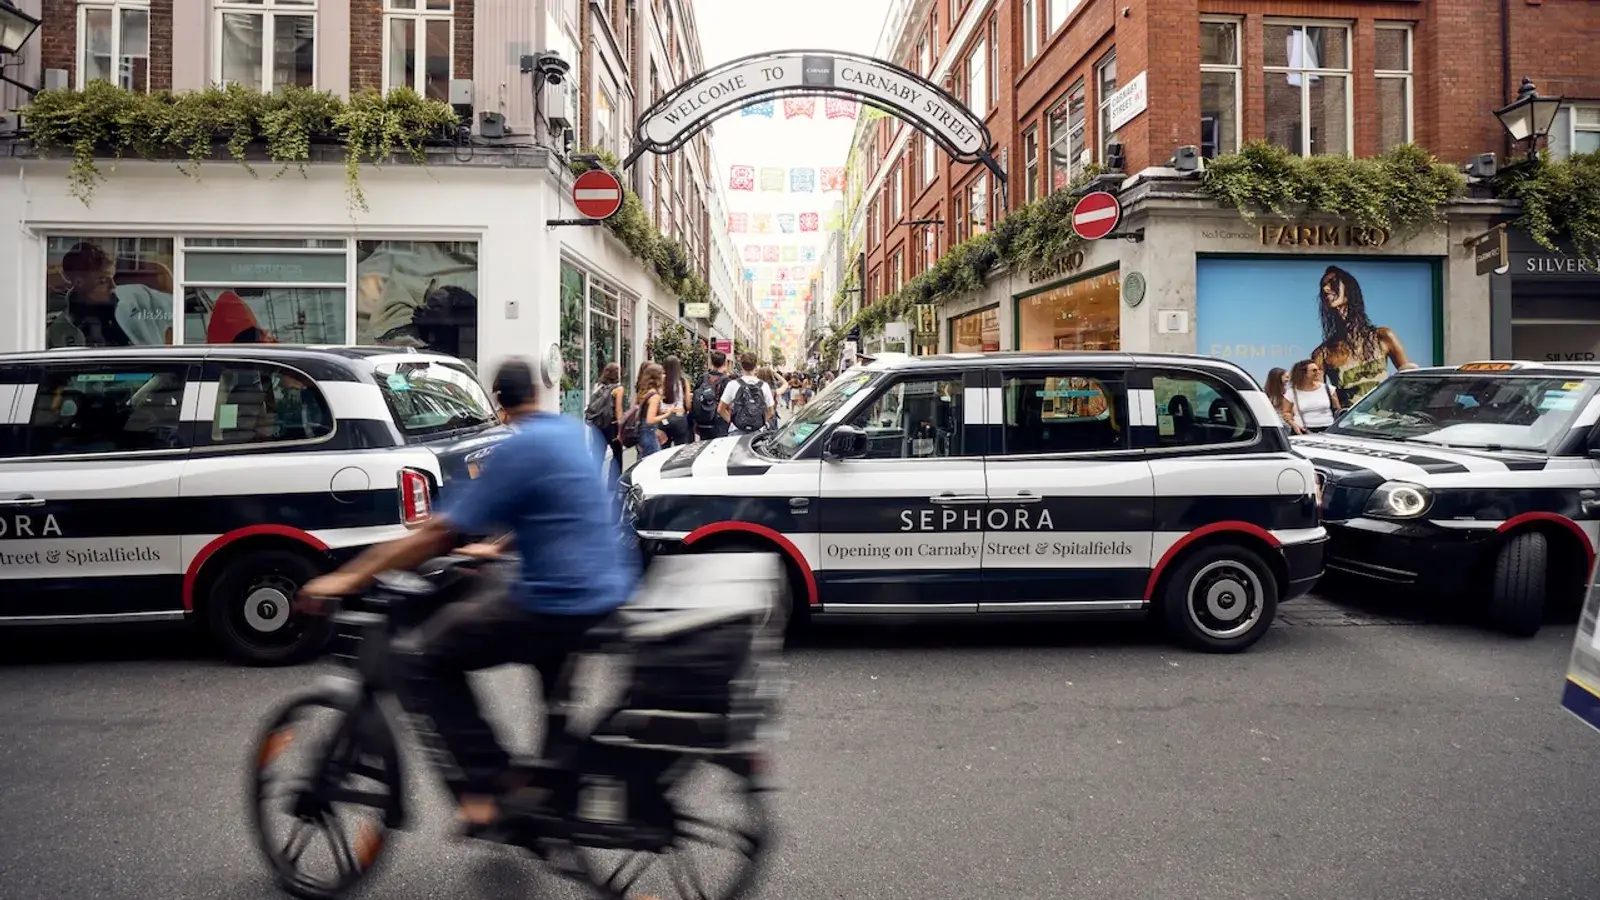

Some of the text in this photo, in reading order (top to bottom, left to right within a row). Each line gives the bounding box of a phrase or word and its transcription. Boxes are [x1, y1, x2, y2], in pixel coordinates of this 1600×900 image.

[664, 67, 784, 126] WELCOME TO
[841, 67, 976, 146] CARNABY STREET
[1260, 224, 1340, 247] FARM
[1527, 258, 1587, 272] SILVER
[1546, 352, 1595, 361] SILVER
[900, 508, 1054, 530] SEPHORA
[46, 550, 61, 564] &
[66, 547, 160, 566] Spitalfields
[827, 541, 1133, 559] Opening on Carnaby Street & Spitalfields
